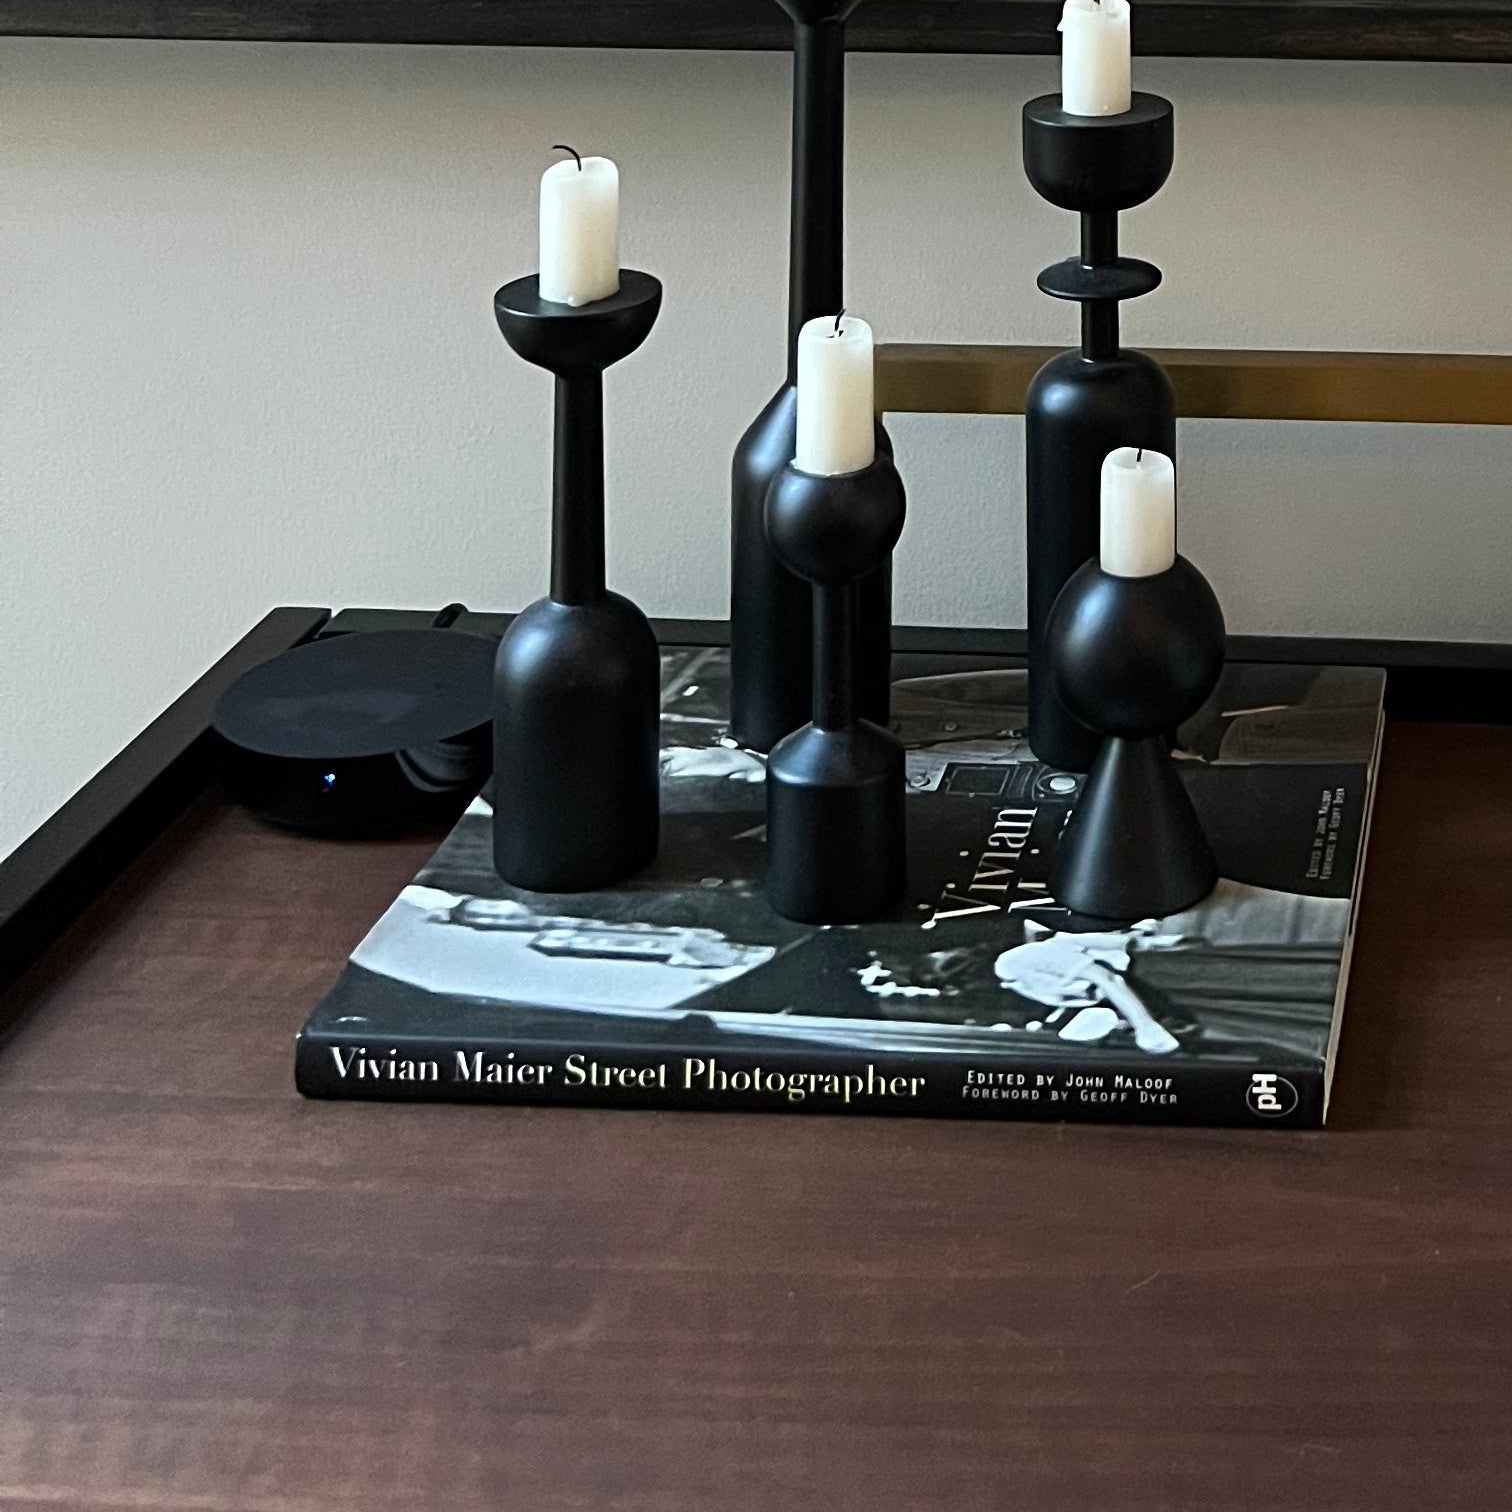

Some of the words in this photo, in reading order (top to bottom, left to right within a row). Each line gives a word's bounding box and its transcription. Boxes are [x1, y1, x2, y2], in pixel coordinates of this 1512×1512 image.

[934, 806, 1039, 920] Vivian
[329, 1046, 440, 1082] Vivian
[453, 1050, 553, 1086] Maier
[563, 1054, 668, 1088] Street
[683, 1058, 926, 1105] Photographer
